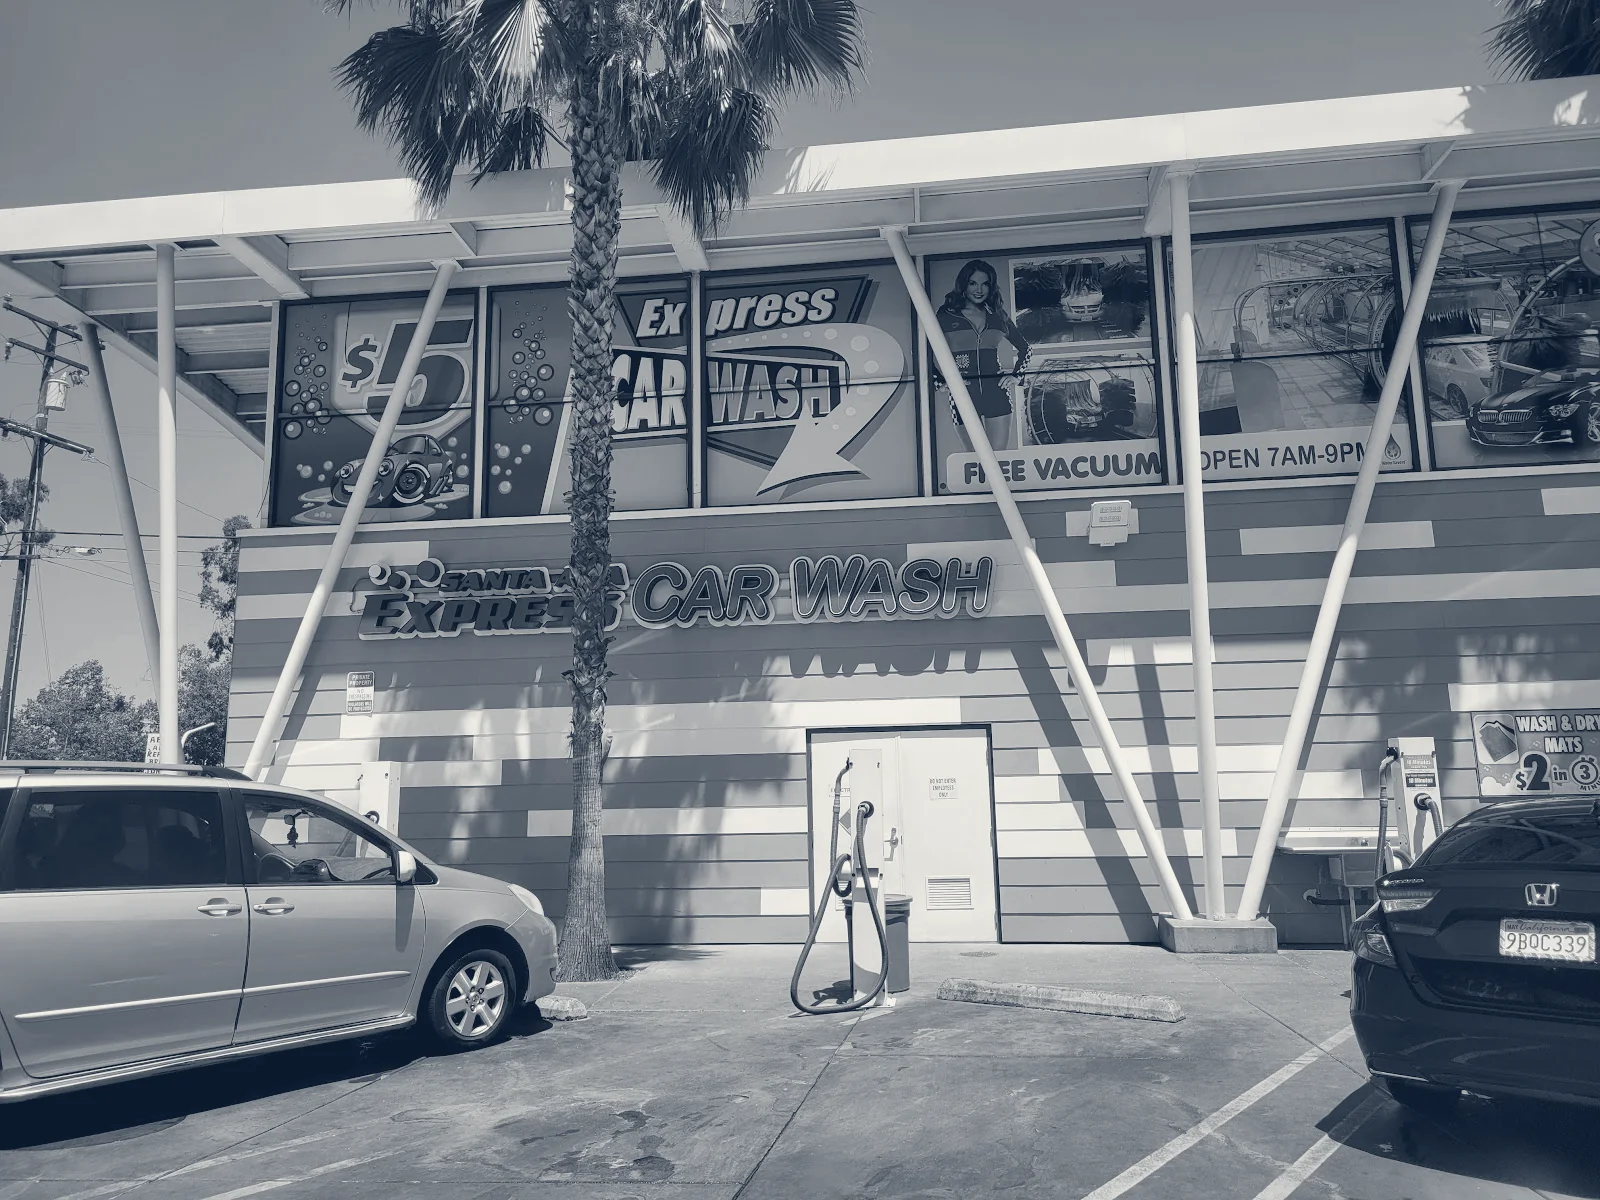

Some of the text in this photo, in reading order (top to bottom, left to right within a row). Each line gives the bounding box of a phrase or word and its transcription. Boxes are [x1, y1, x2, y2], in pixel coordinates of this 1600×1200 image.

[611, 354, 831, 432] CAR WASH
[1033, 451, 1162, 481] VACUUM
[440, 569, 547, 591] SANTA
[632, 563, 777, 624] CAR
[791, 556, 994, 618] WASH
[1515, 715, 1558, 733] WASH
[1560, 714, 1574, 732] &
[1544, 737, 1583, 753] MATS
[1515, 753, 1591, 791] $2 in 3
[1519, 922, 1573, 933] California
[1506, 932, 1587, 954] 9BQC339
